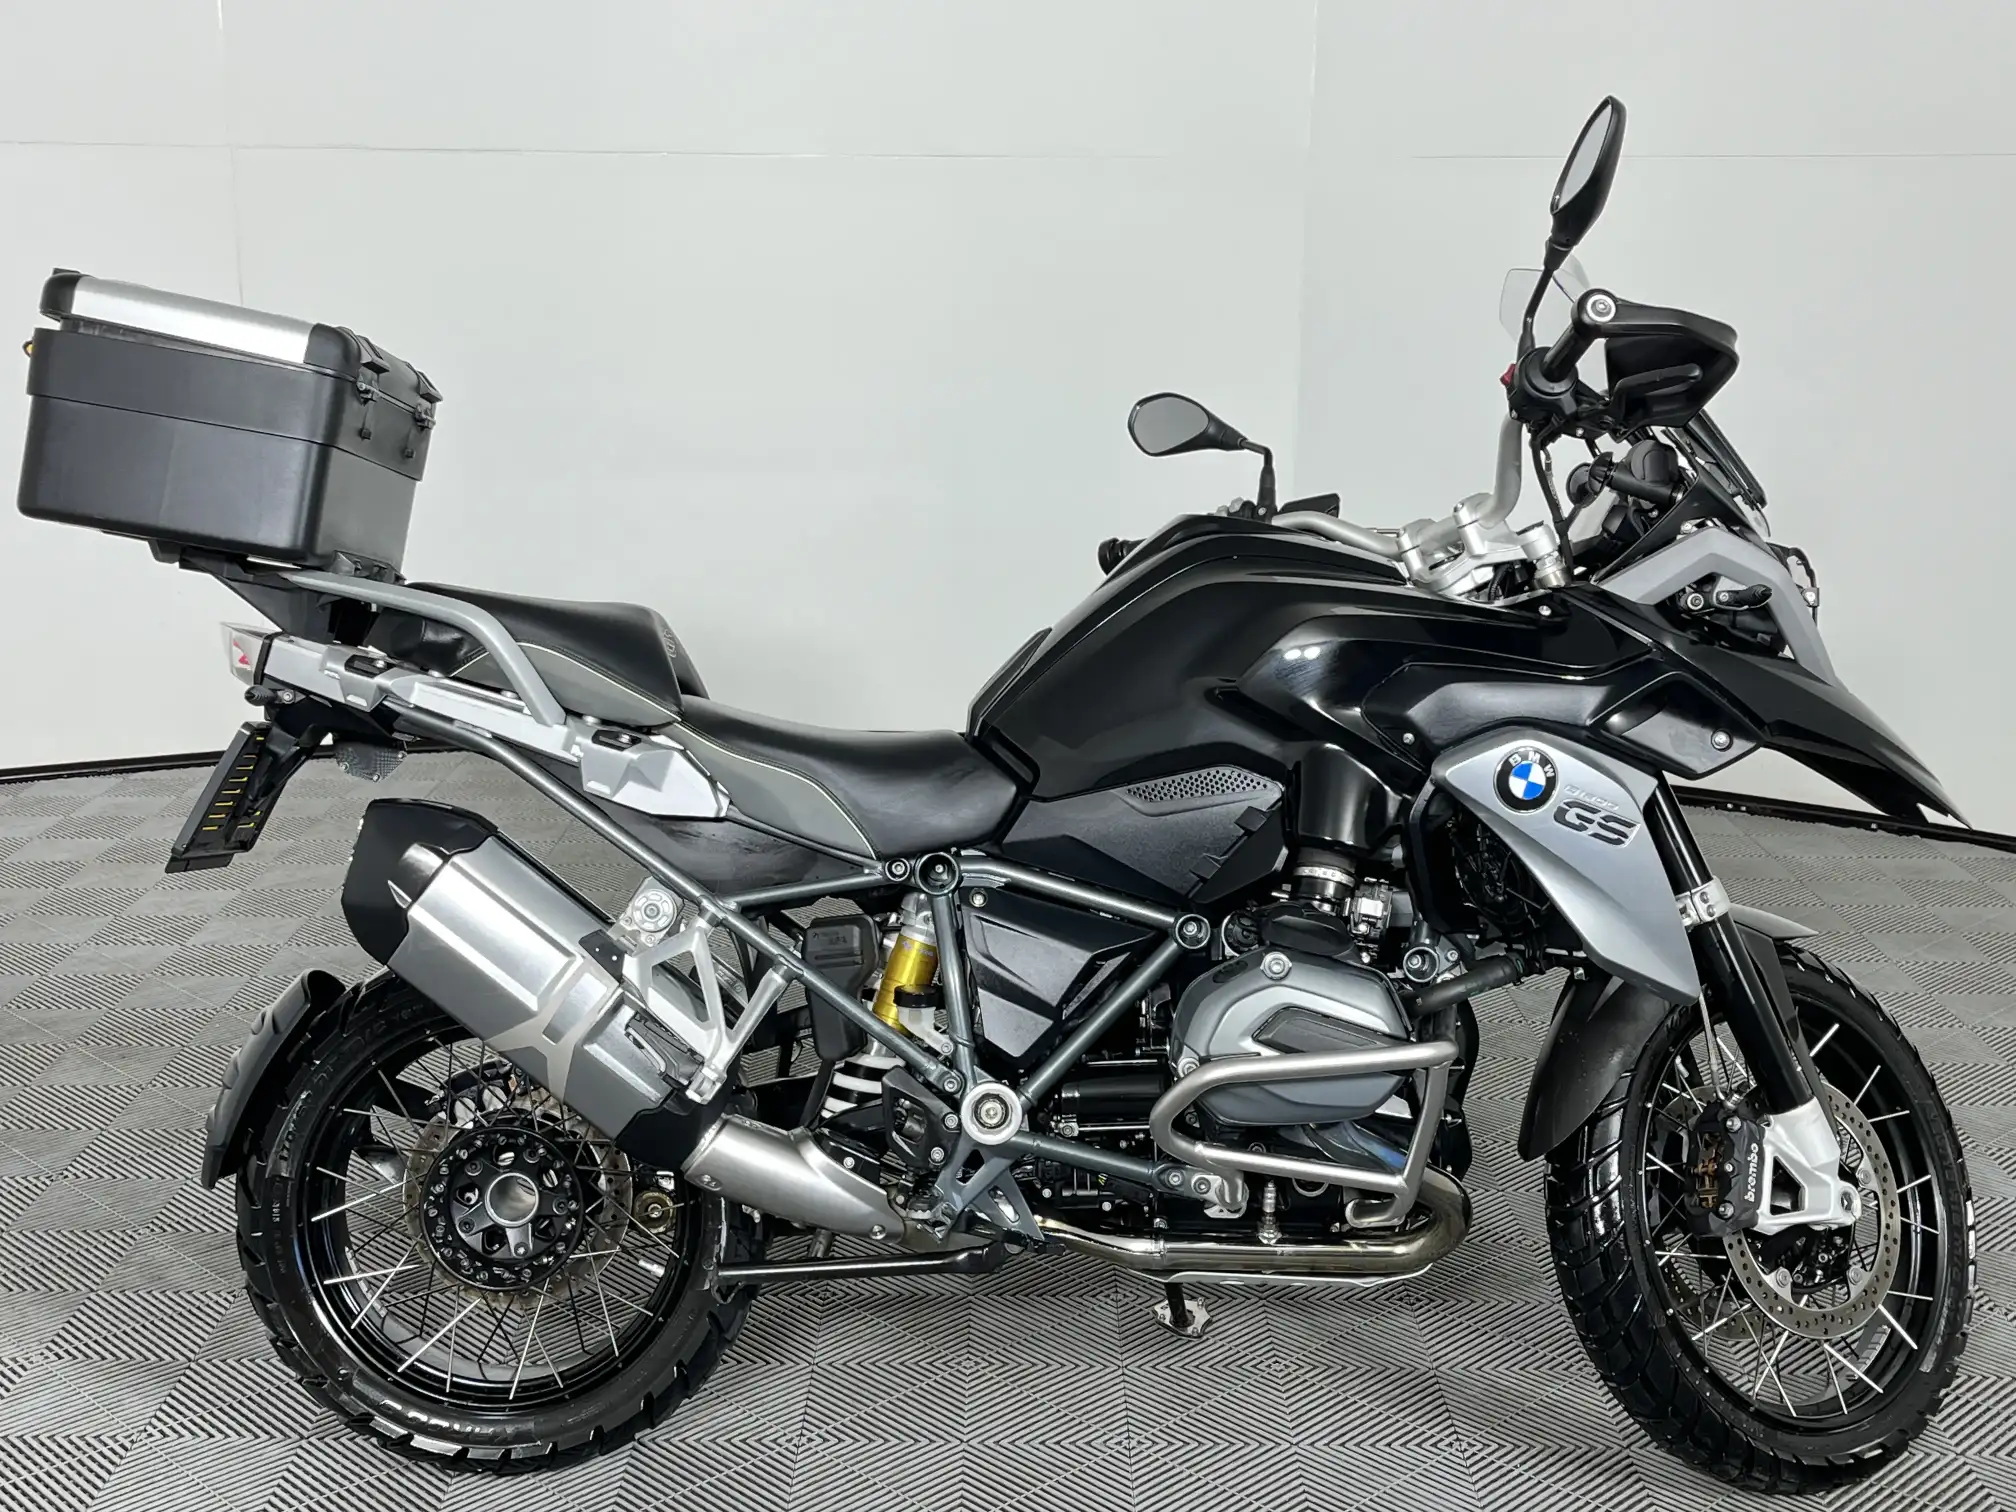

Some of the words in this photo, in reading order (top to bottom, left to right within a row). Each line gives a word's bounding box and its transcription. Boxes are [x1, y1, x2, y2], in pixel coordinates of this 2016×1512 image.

[1508, 750, 1555, 778] BMW
[1553, 798, 1639, 847] GS
[1744, 1142, 1759, 1203] brembo
